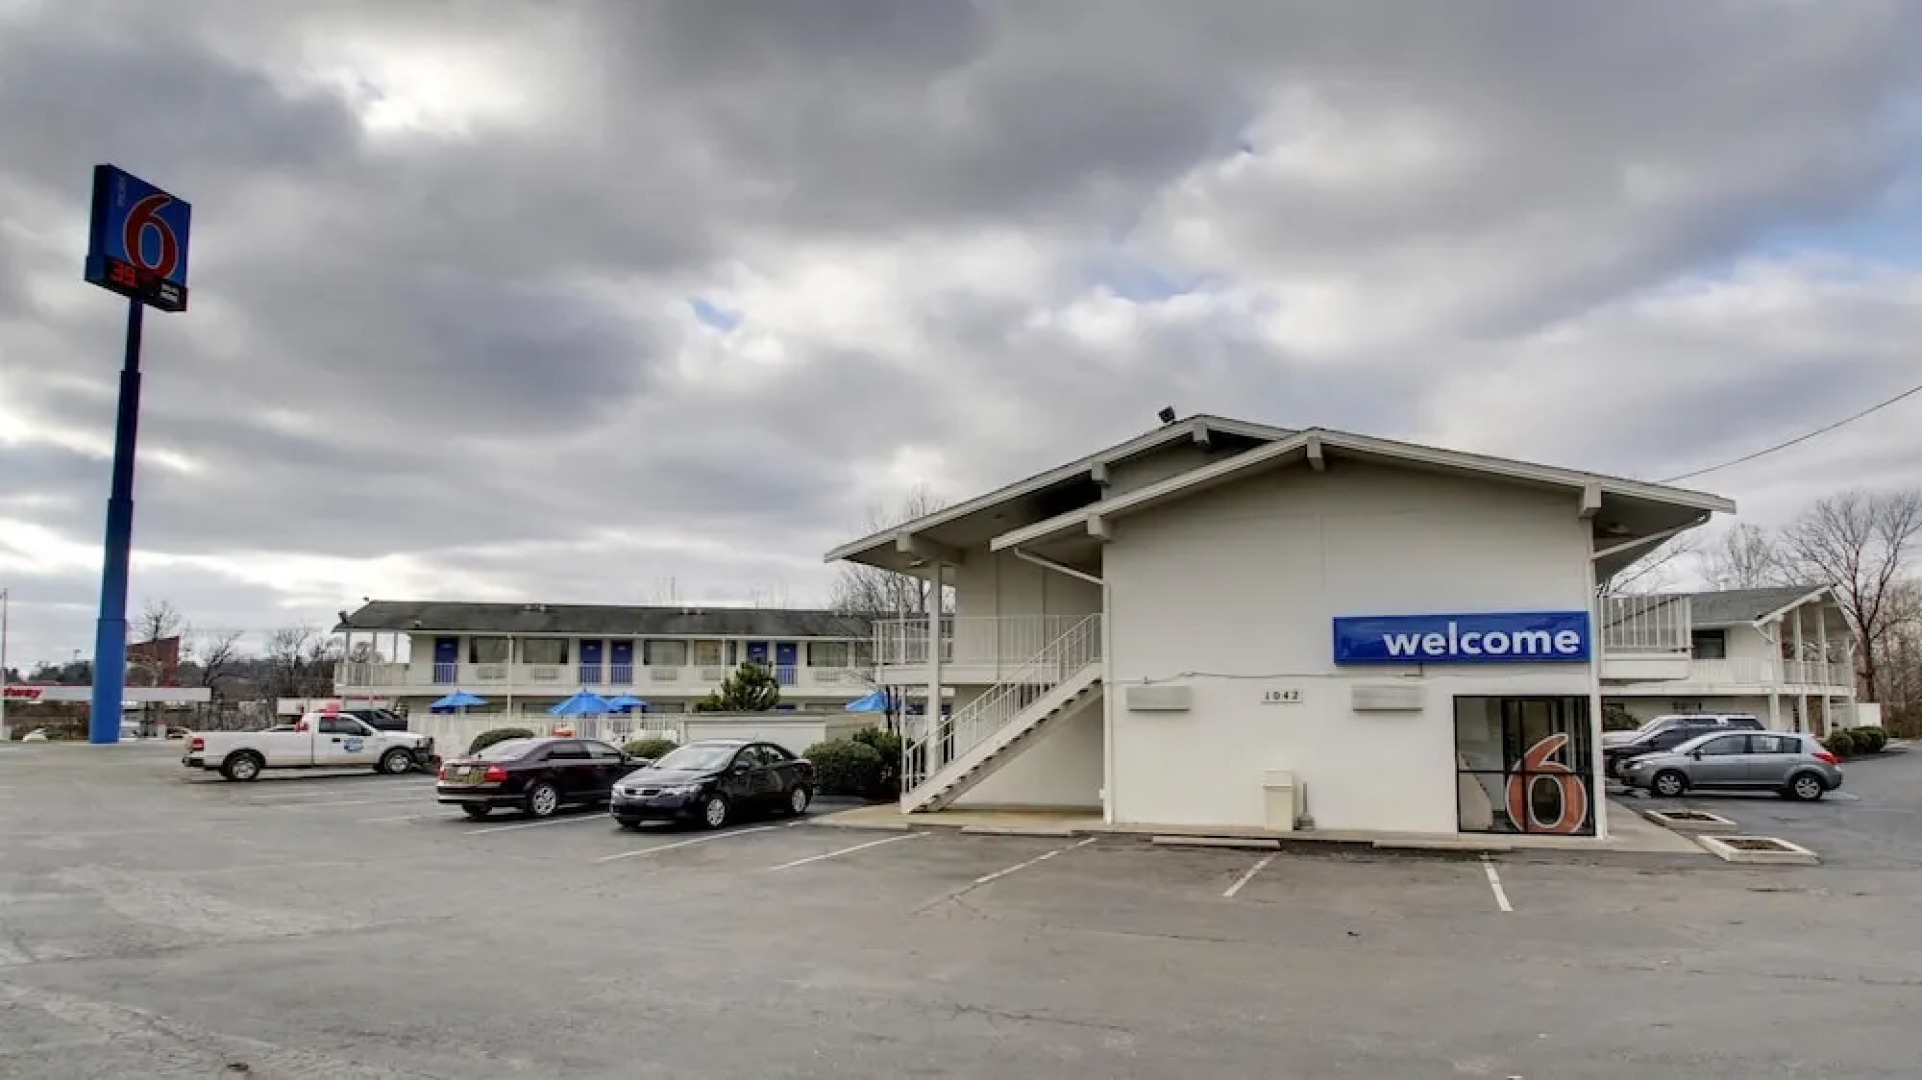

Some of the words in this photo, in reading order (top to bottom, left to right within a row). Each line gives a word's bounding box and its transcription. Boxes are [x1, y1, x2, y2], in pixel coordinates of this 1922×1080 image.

[122, 193, 179, 279] 6
[1382, 621, 1581, 656] welcome
[1265, 691, 1299, 700] 1042
[1505, 733, 1588, 832] 6
